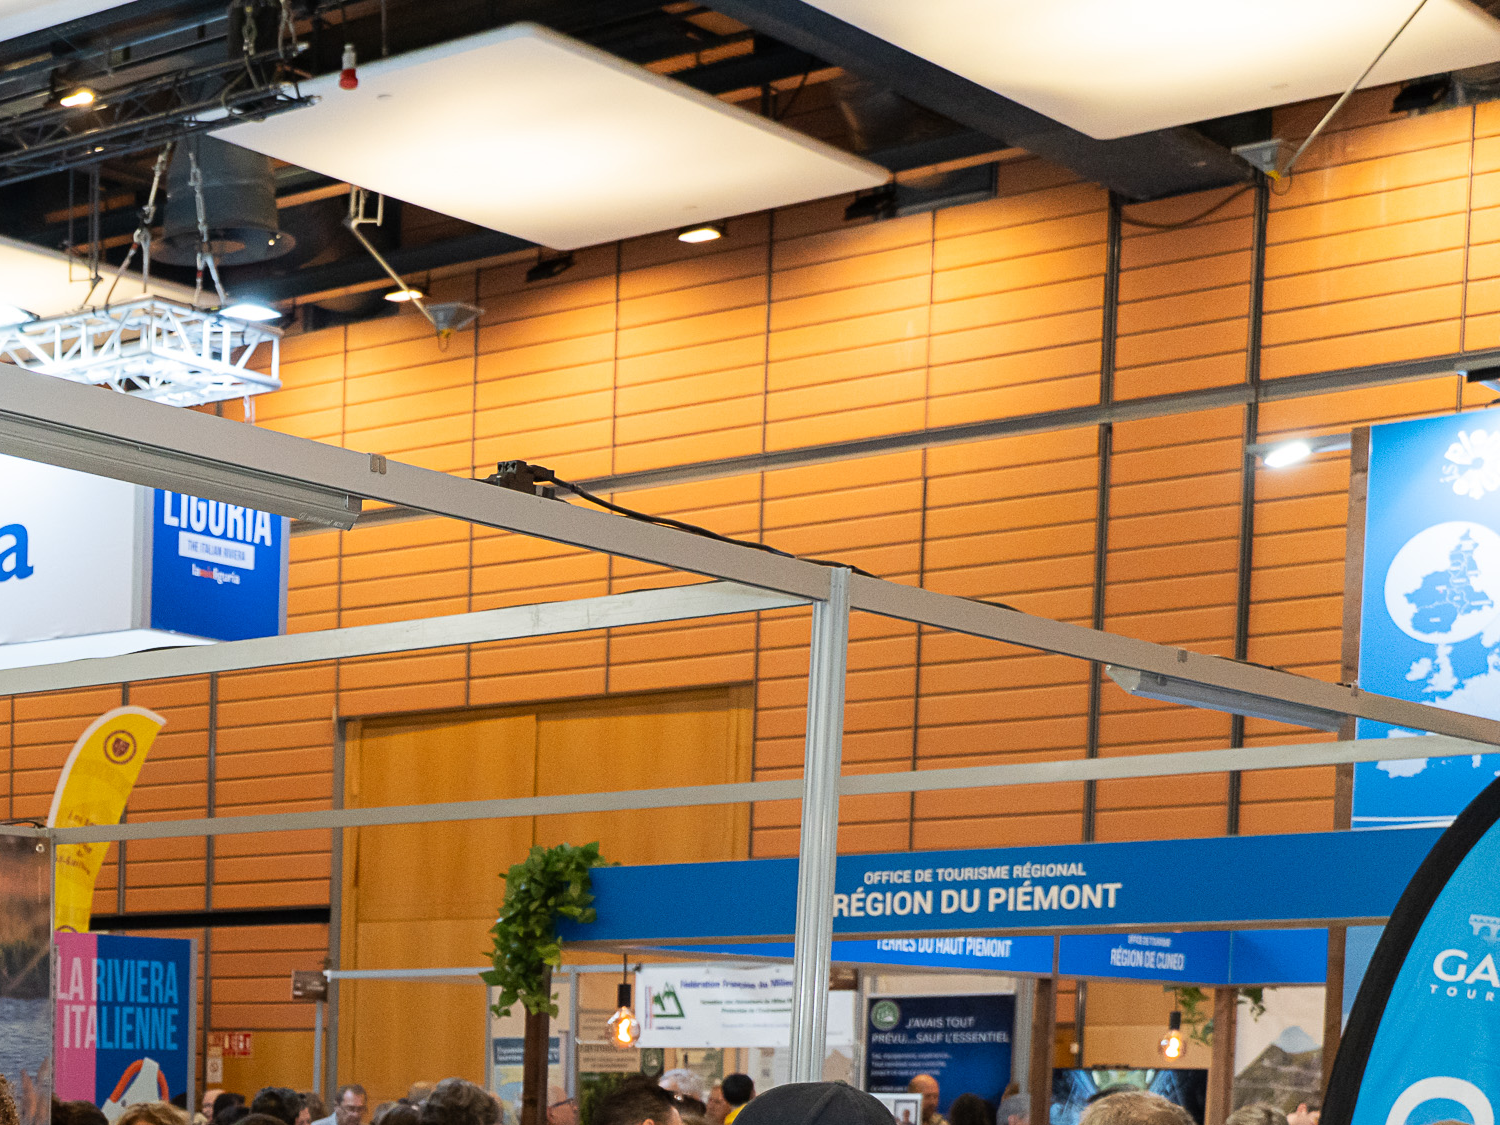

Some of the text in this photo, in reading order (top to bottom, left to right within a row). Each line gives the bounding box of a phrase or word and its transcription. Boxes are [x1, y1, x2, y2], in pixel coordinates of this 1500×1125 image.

[164, 490, 272, 547] LIGURIA
[864, 861, 1086, 885] OFFICE DE TOURISME RÉGIONAL
[833, 880, 1122, 917] RÉGION DU PIÉMONT
[918, 937, 934, 954] DU
[935, 937, 965, 955] HAUT
[1110, 945, 1185, 971] RÉGION DE CUNEO
[57, 955, 178, 1004] LA RIVIERA
[1430, 983, 1495, 1002] TOUR
[63, 1005, 178, 1050] ITALIENNE
[905, 1016, 975, 1029] J'AVAIS TOUT
[945, 1030, 1009, 1043] L'ESSENTIEL
